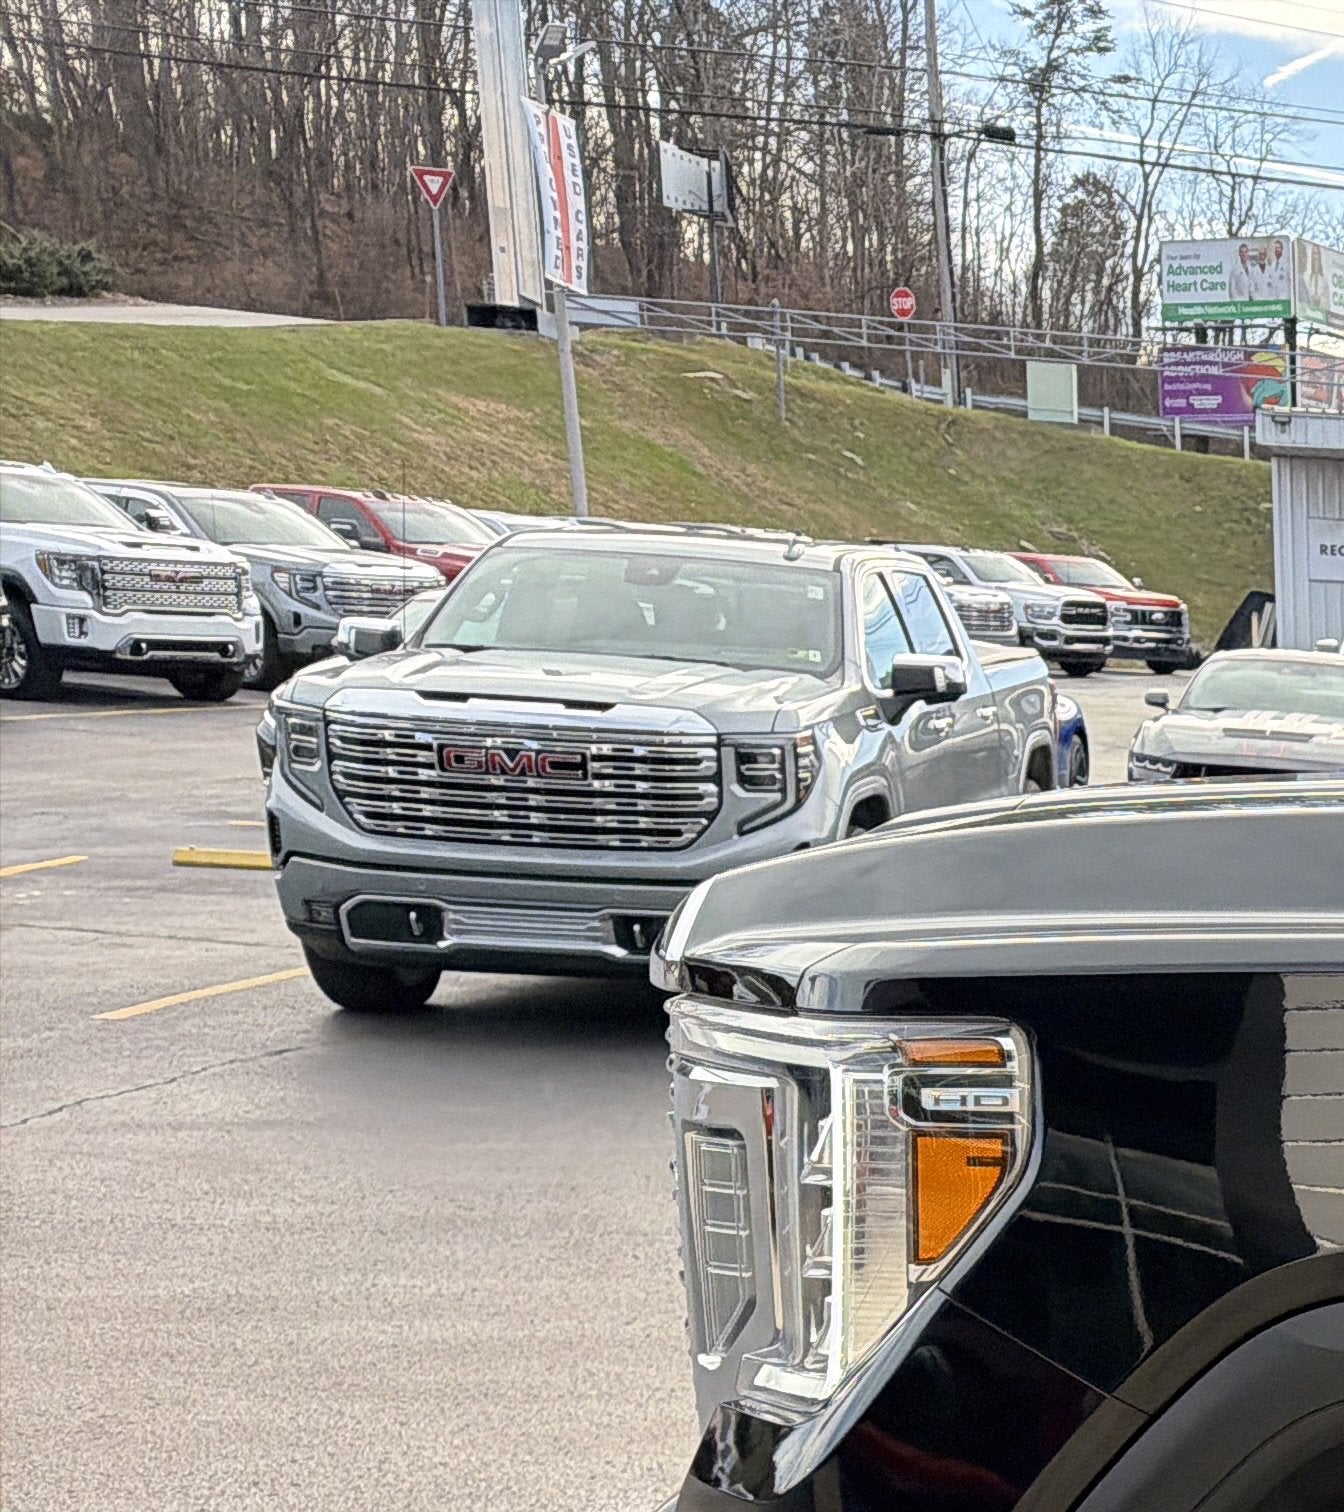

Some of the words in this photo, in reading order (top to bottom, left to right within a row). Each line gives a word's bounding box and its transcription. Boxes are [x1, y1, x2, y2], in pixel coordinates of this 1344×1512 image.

[562, 124, 582, 197] USED
[574, 209, 585, 281] CARS
[1166, 261, 1223, 277] Advanced
[1166, 279, 1199, 293] Heart
[1200, 278, 1227, 292] Care
[892, 297, 913, 310] STOP
[442, 746, 583, 778] GMC
[930, 1092, 1011, 1108] HD
